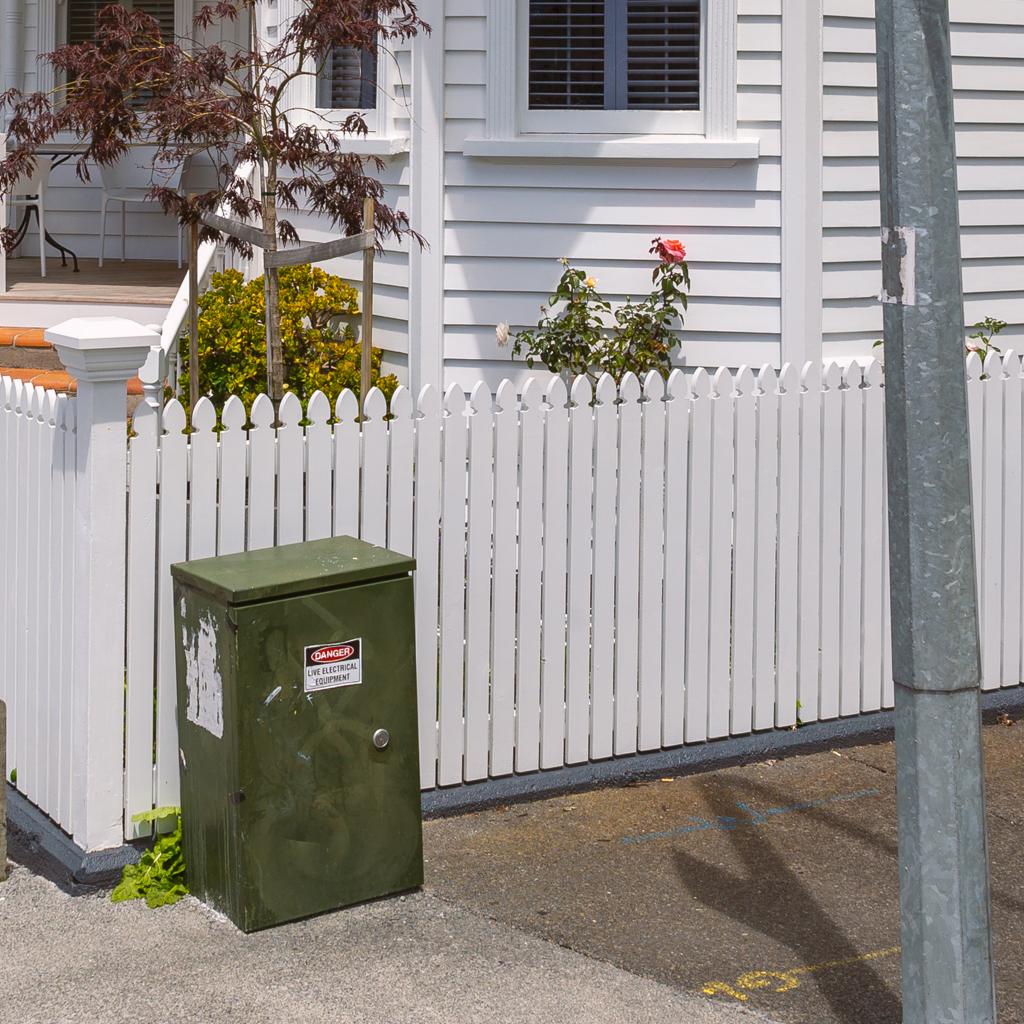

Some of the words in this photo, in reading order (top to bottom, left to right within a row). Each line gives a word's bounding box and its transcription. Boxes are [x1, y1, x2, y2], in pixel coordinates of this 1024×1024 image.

[315, 648, 350, 660] DANGER
[322, 663, 357, 674] ELECTRICAL
[315, 673, 350, 686] EQUIPMENT
